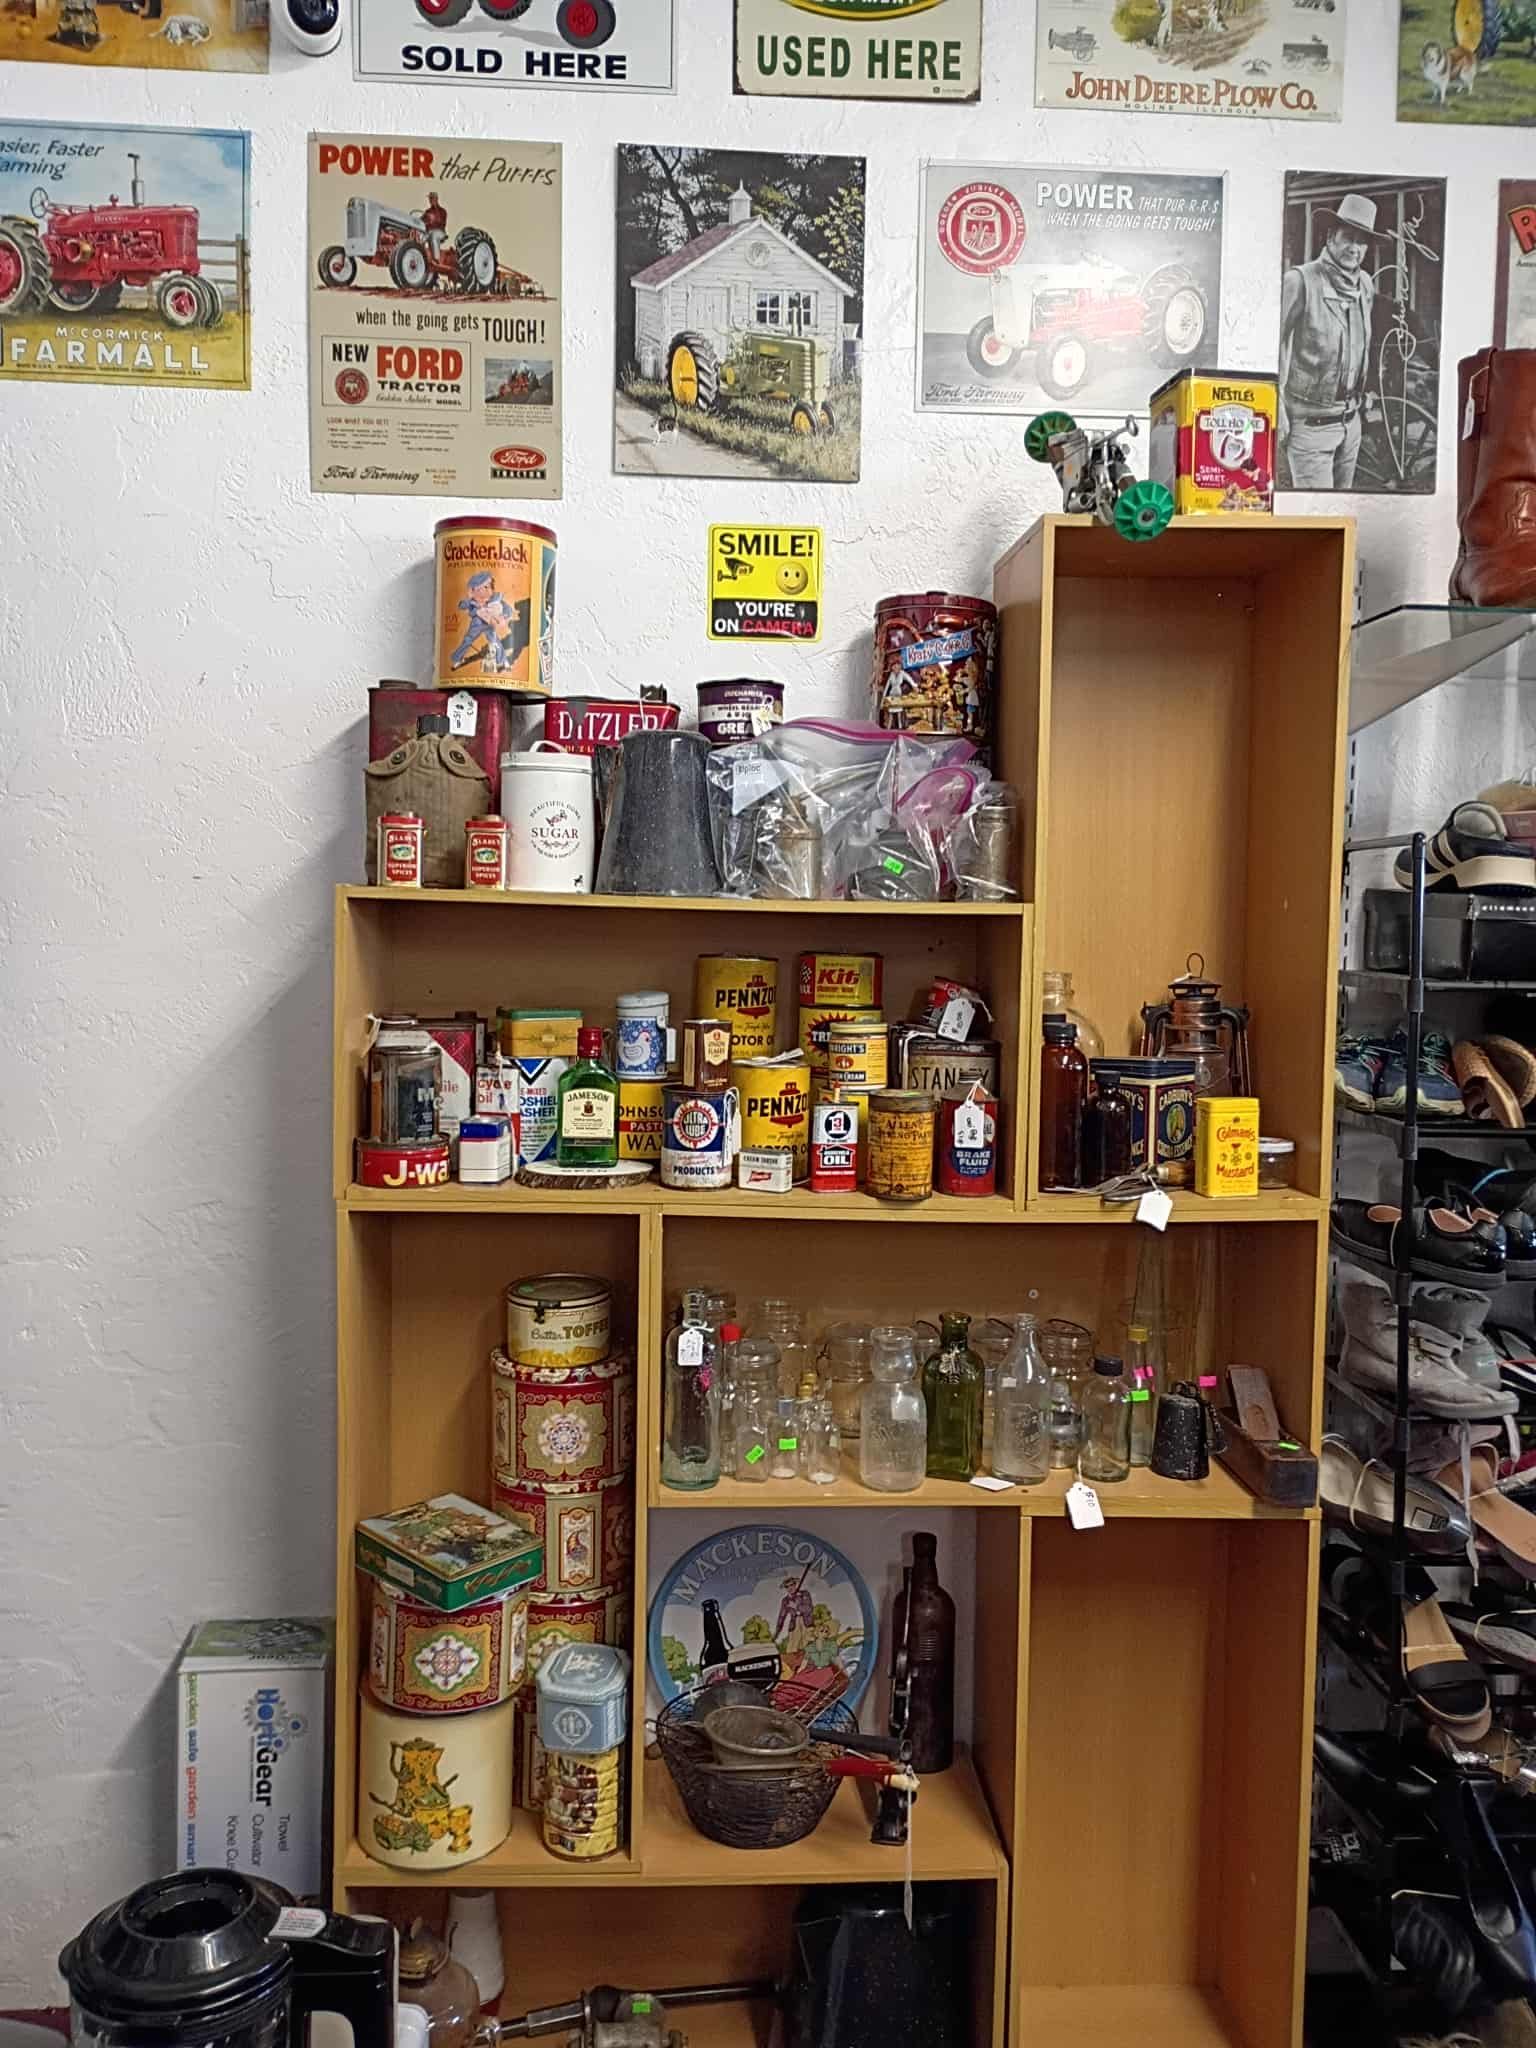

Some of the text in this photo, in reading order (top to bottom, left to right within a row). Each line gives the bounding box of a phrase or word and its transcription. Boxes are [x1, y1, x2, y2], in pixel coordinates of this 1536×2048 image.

[402, 45, 627, 80] SOLD HERE
[757, 35, 961, 80] USED HERE
[1065, 71, 1129, 101] JOHN
[1134, 75, 1211, 105] DEERE
[1213, 79, 1279, 109] PLOW
[0, 139, 104, 158] asier, Faster
[0, 157, 66, 180] arming
[319, 144, 435, 179] POWER
[440, 152, 480, 181] that
[1036, 181, 1135, 211] POWER
[1138, 196, 1163, 211] THAT
[1047, 211, 1216, 232] WHEN THE GOING GETS TOUGH!
[355, 309, 546, 344] when the going gets TOUGH!
[10, 338, 210, 370] FARMALL
[331, 343, 464, 382] NEW FORD
[377, 379, 462, 395] TRACTOR
[500, 450, 537, 465] Ford
[323, 465, 355, 480] Ford
[360, 465, 420, 485] Farming
[443, 539, 495, 562] Cracker
[718, 533, 815, 557] SMILE!
[735, 602, 796, 617] YOU'RE
[714, 618, 739, 633] ON
[717, 722, 752, 735] GREA
[531, 827, 579, 839] SUGAR
[817, 968, 860, 985] Kit
[715, 985, 777, 1009] PENNZO
[911, 1066, 990, 1091] STANY
[519, 1096, 558, 1107] DSHIEL
[567, 1091, 610, 1104] JAMESON
[747, 1092, 808, 1118] PENNZO
[519, 1107, 556, 1117] ASHER
[619, 1105, 664, 1118] OHNSO
[823, 1155, 850, 1165] OIL
[956, 1150, 992, 1159] BRAKE
[959, 1158, 989, 1167] FLUID
[383, 1159, 449, 1186] J-wa
[673, 1165, 715, 1176] PRODUCTS
[1216, 1162, 1255, 1178] Mustard
[671, 1531, 838, 1606] MACKESON
[734, 1659, 773, 1673] MACKESON
[250, 1813, 265, 1868] Cultivator
[277, 1814, 291, 1853] Trowel
[186, 1823, 198, 1867] smart
